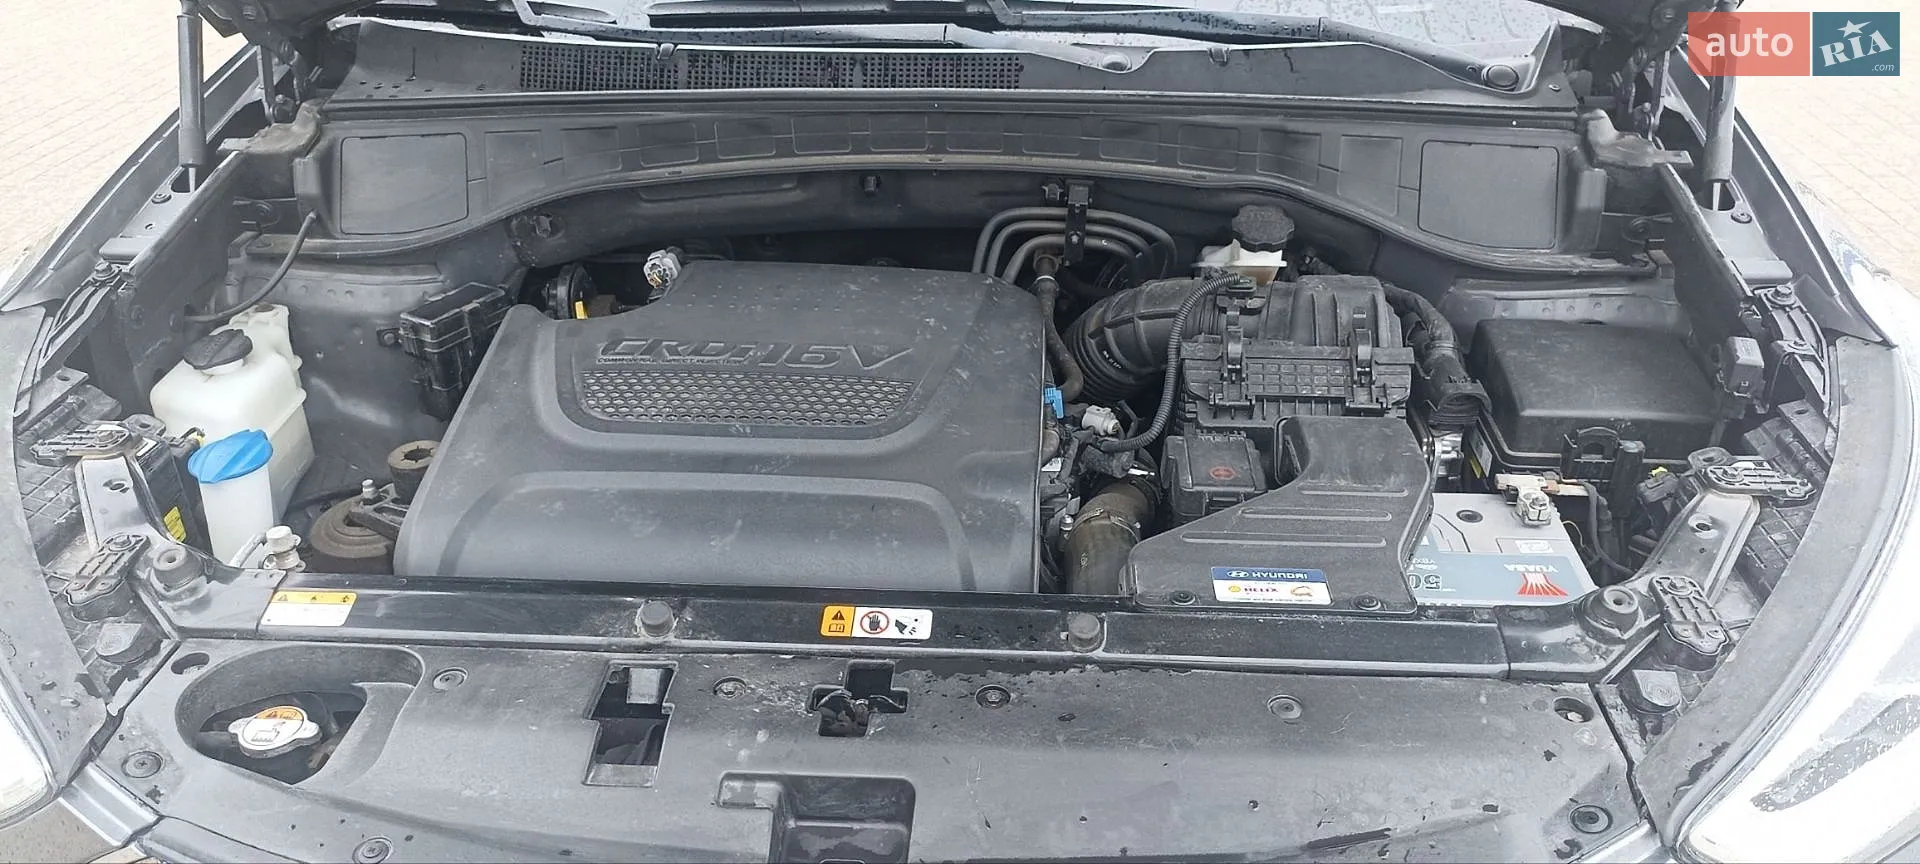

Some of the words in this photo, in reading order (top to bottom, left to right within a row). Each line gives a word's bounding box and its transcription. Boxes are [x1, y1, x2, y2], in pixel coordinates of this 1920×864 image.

[758, 344, 914, 370] 16V
[1503, 564, 1559, 573] YUASA
[1252, 571, 1308, 580] HYUNDAI
